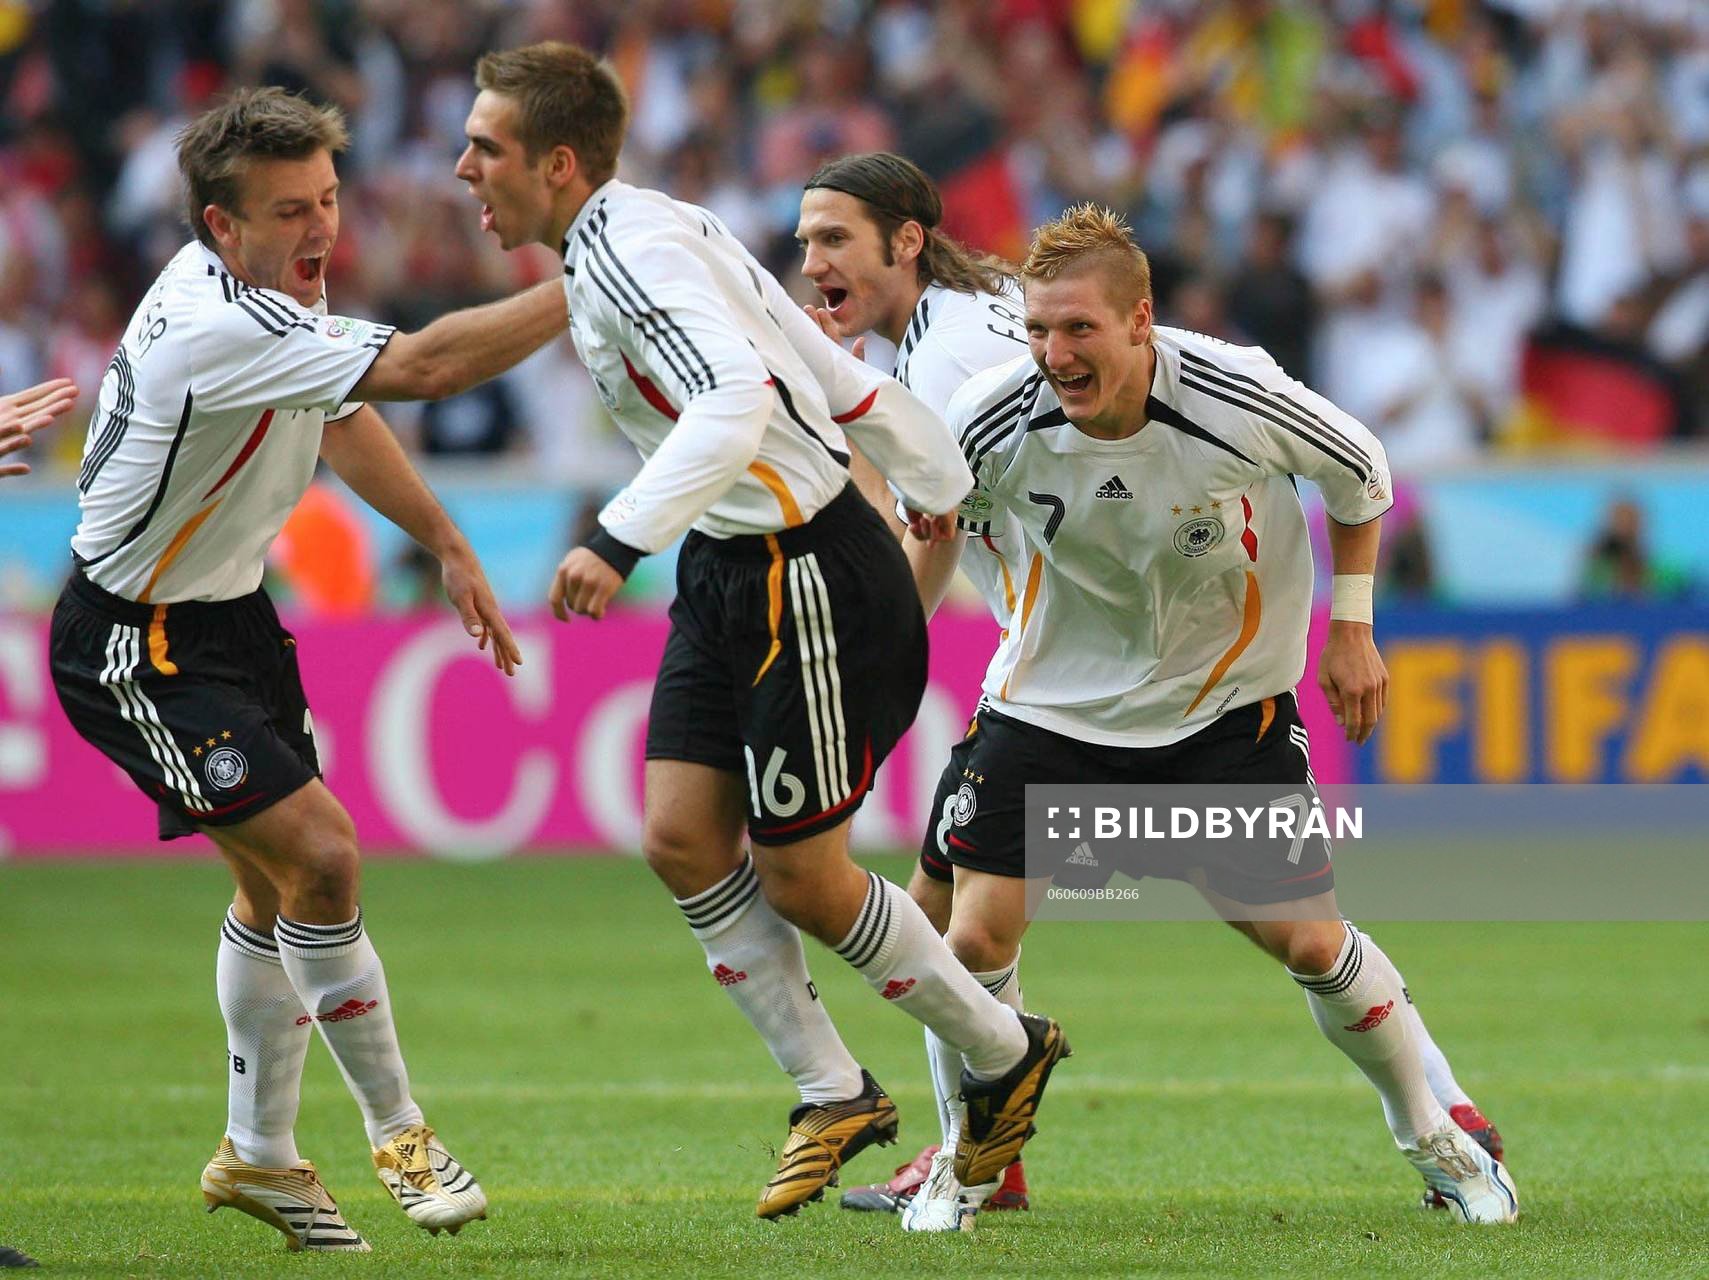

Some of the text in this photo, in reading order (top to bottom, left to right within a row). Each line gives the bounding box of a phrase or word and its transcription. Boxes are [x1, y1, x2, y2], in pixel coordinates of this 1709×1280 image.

[1028, 490, 1065, 546] 7
[1095, 490, 1134, 499] adidas
[1379, 637, 1709, 786] FIFA
[744, 745, 806, 819] 16
[1269, 794, 1309, 865] 7
